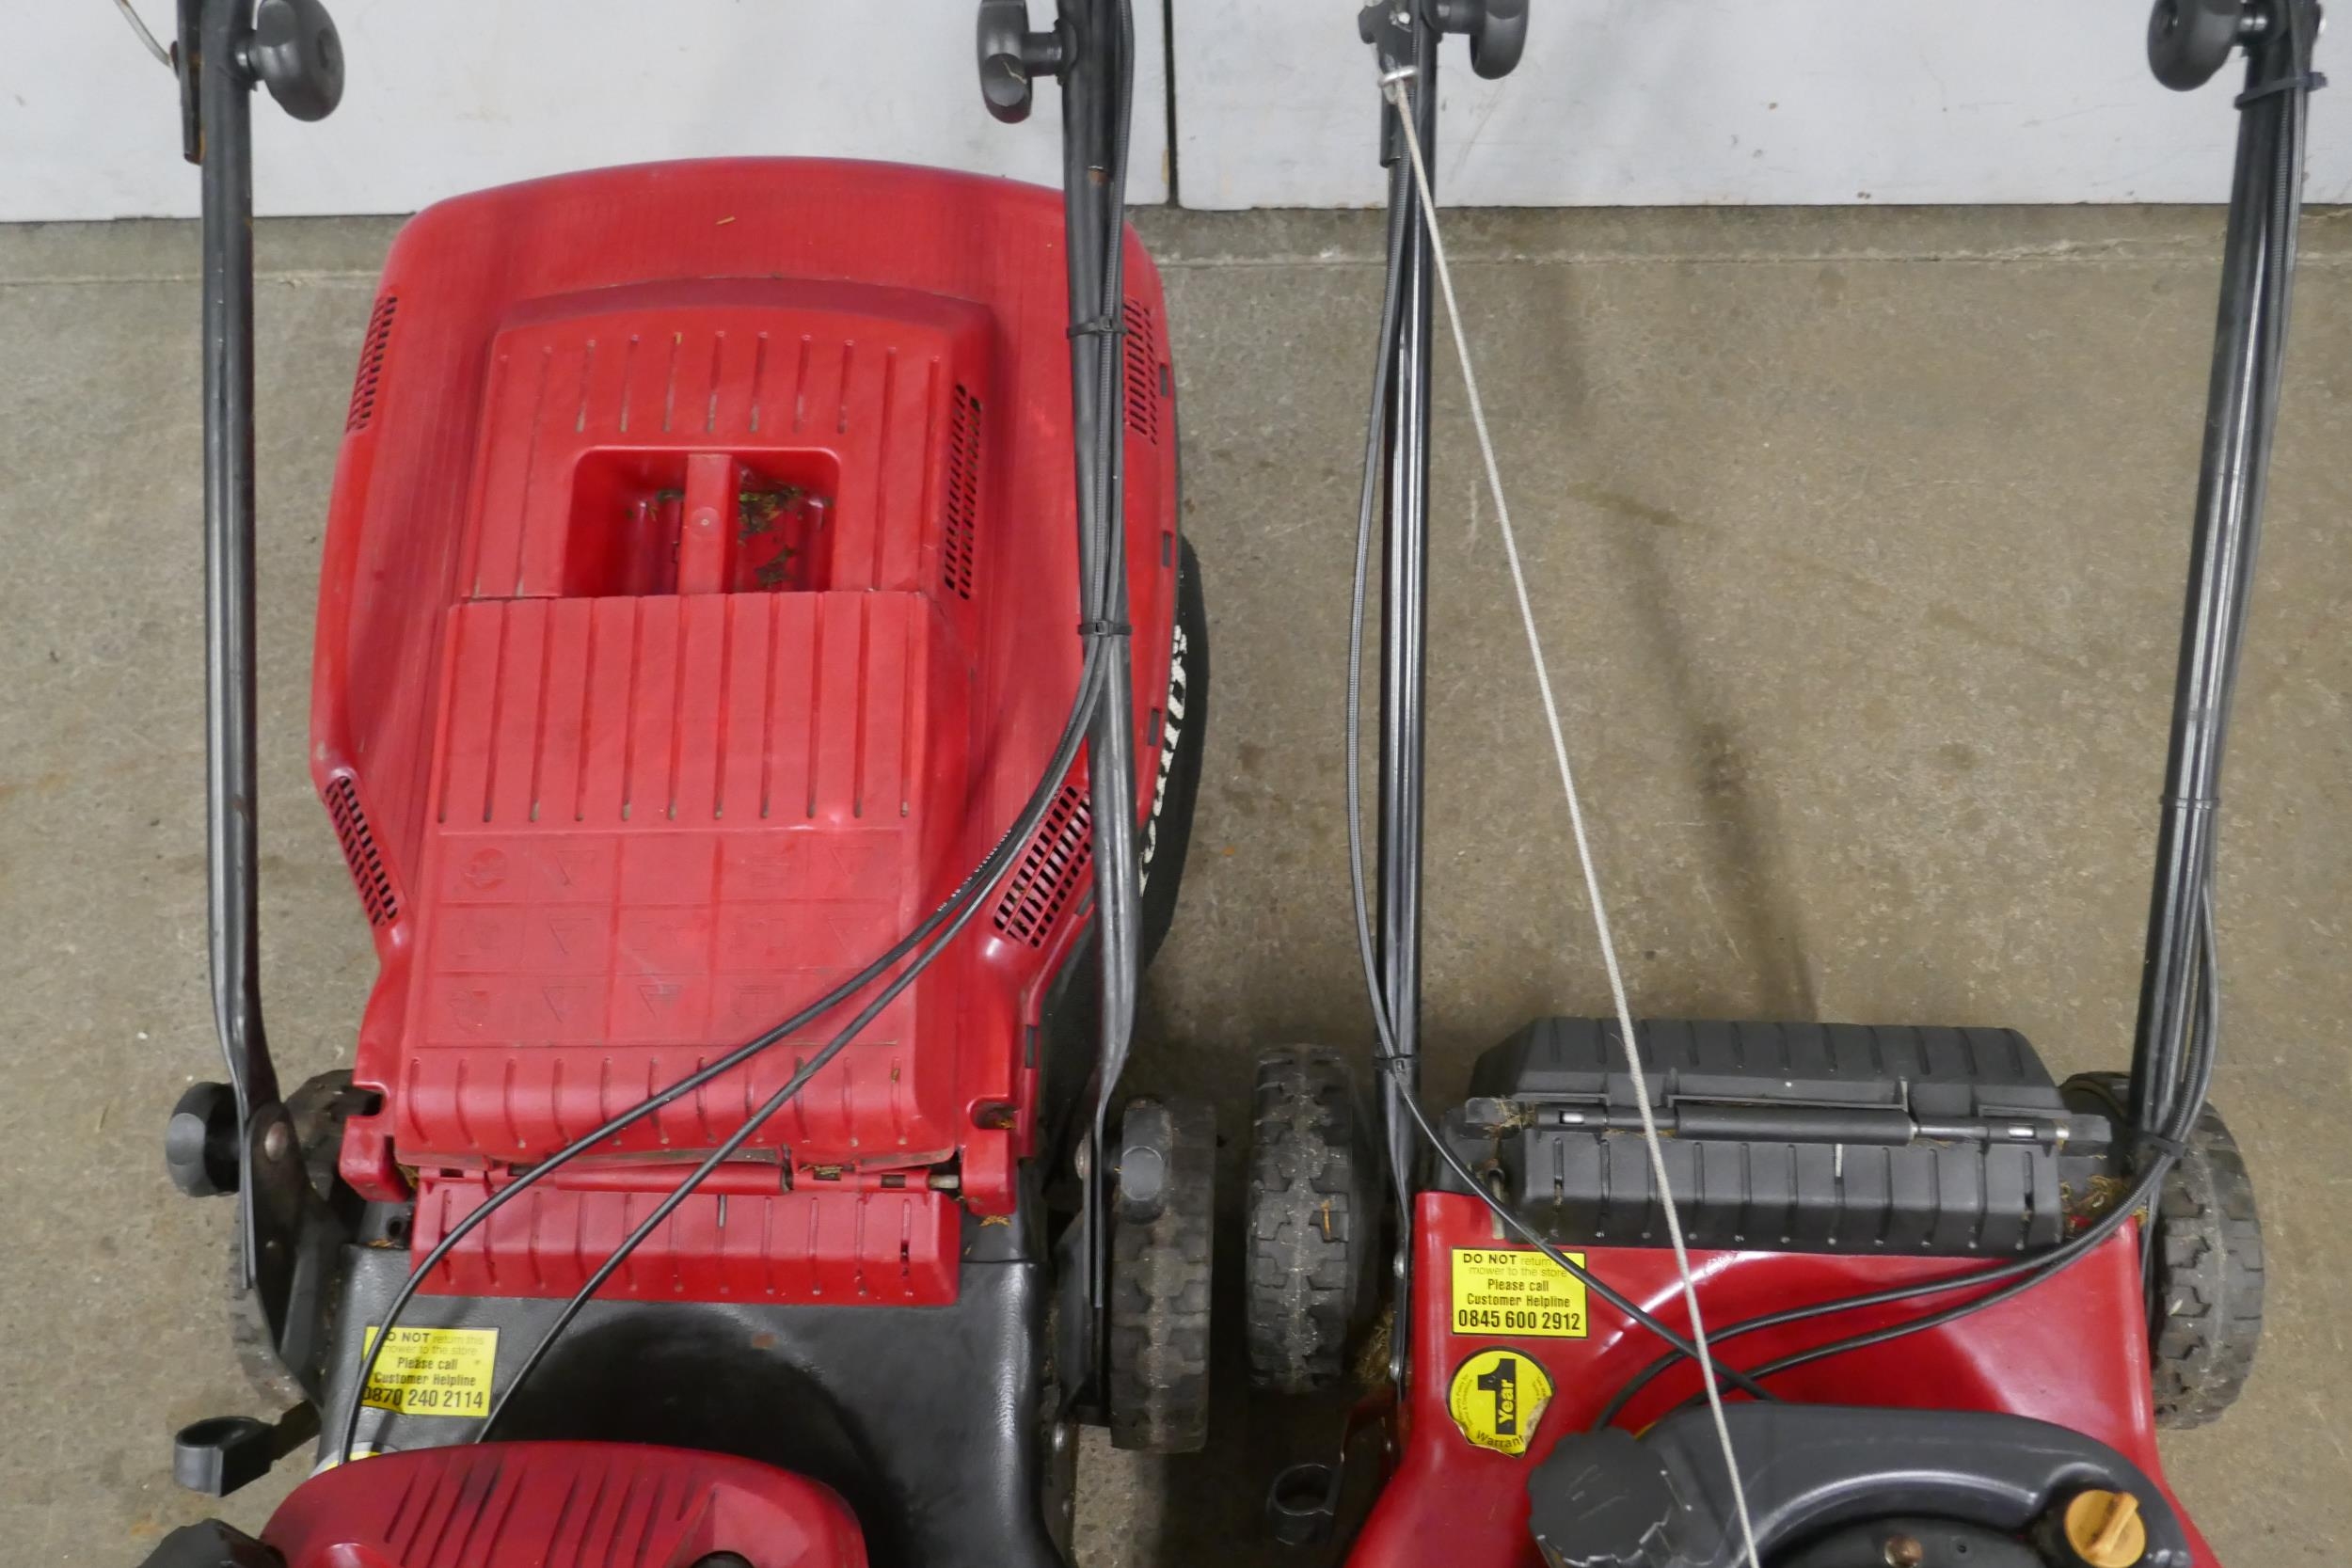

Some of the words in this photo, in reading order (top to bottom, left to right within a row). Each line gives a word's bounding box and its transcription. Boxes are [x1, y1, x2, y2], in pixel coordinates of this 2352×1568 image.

[1463, 1253, 1483, 1264] DO
[1488, 1254, 1518, 1265] NOT
[1520, 1257, 1552, 1266] return
[1469, 1266, 1504, 1275] mower
[1507, 1266, 1518, 1276] to
[1520, 1267, 1537, 1276] the
[1541, 1268, 1567, 1278] store
[1487, 1278, 1525, 1291] Please
[1529, 1280, 1549, 1291] call
[1467, 1292, 1521, 1307] Customer
[1526, 1295, 1570, 1308] Helpline
[1458, 1309, 1501, 1328] 0845
[1505, 1310, 1536, 1329] 600
[1542, 1311, 1581, 1330] 2912
[402, 1332, 430, 1343] NOT
[420, 1346, 429, 1354] to
[432, 1346, 447, 1354] the
[397, 1356, 434, 1370] Please
[437, 1358, 458, 1370] call
[374, 1371, 429, 1385] Customer
[433, 1373, 476, 1387] Helpline
[407, 1388, 437, 1407] 240
[443, 1389, 483, 1408] 2114
[1477, 1358, 1517, 1435] 1
[1498, 1379, 1515, 1424] Year
